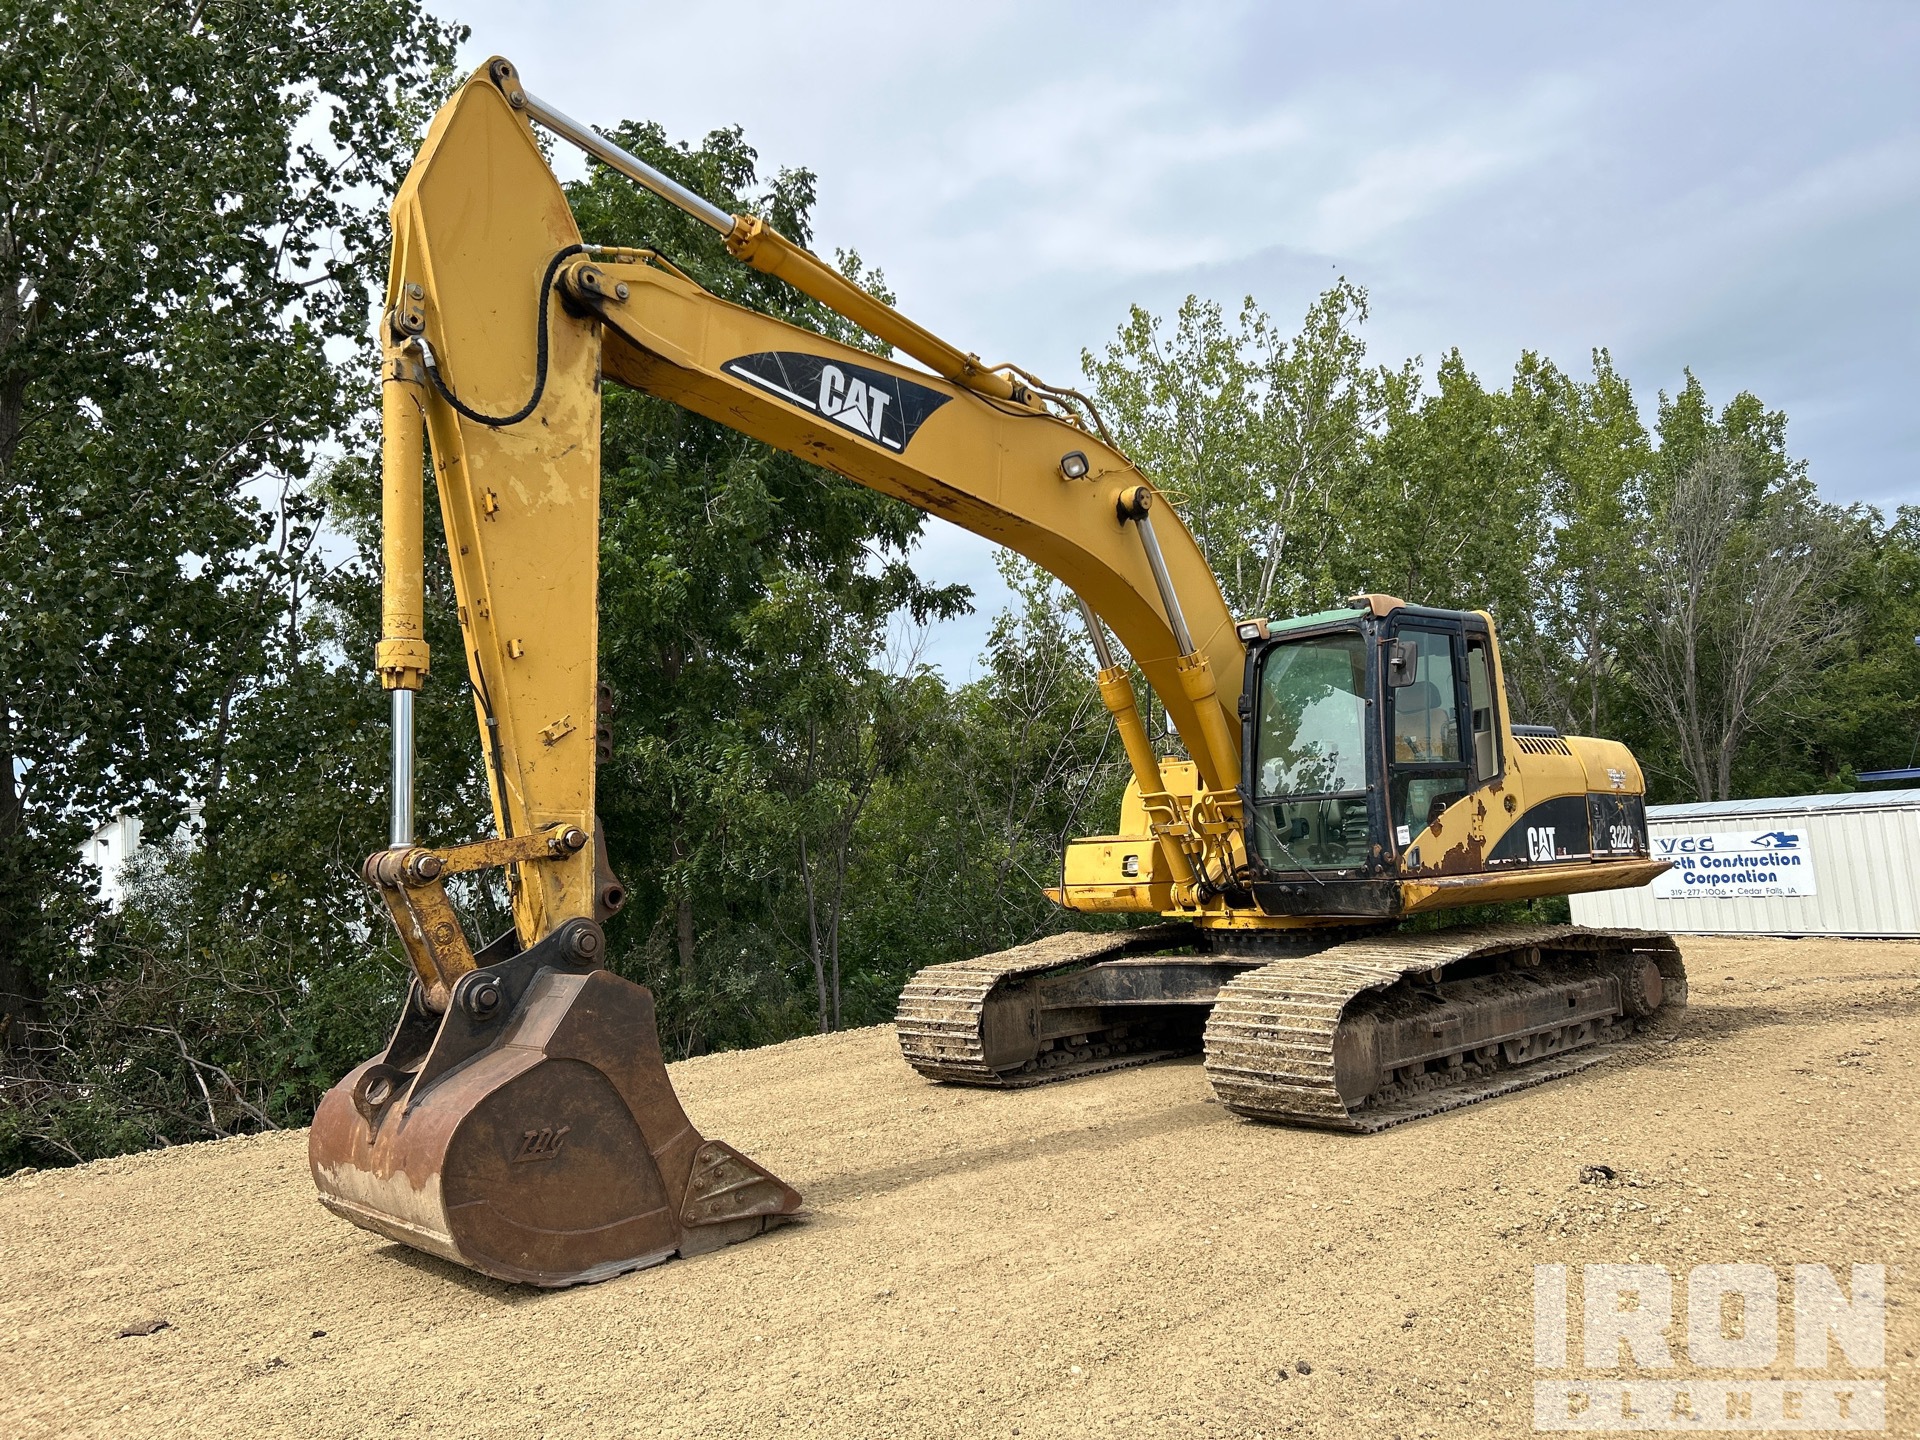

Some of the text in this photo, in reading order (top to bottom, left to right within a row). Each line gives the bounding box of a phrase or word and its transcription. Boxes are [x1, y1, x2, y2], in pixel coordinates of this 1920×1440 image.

[819, 364, 890, 440] CAT
[1527, 827, 1555, 862] CAT
[1610, 825, 1634, 848] 322C
[1653, 836, 1715, 853] VCC
[1658, 853, 1801, 869] eth Construction
[1683, 870, 1778, 887] Corporation
[1670, 888, 1727, 896] 319-277-1006
[1737, 887, 1762, 895] Cedar
